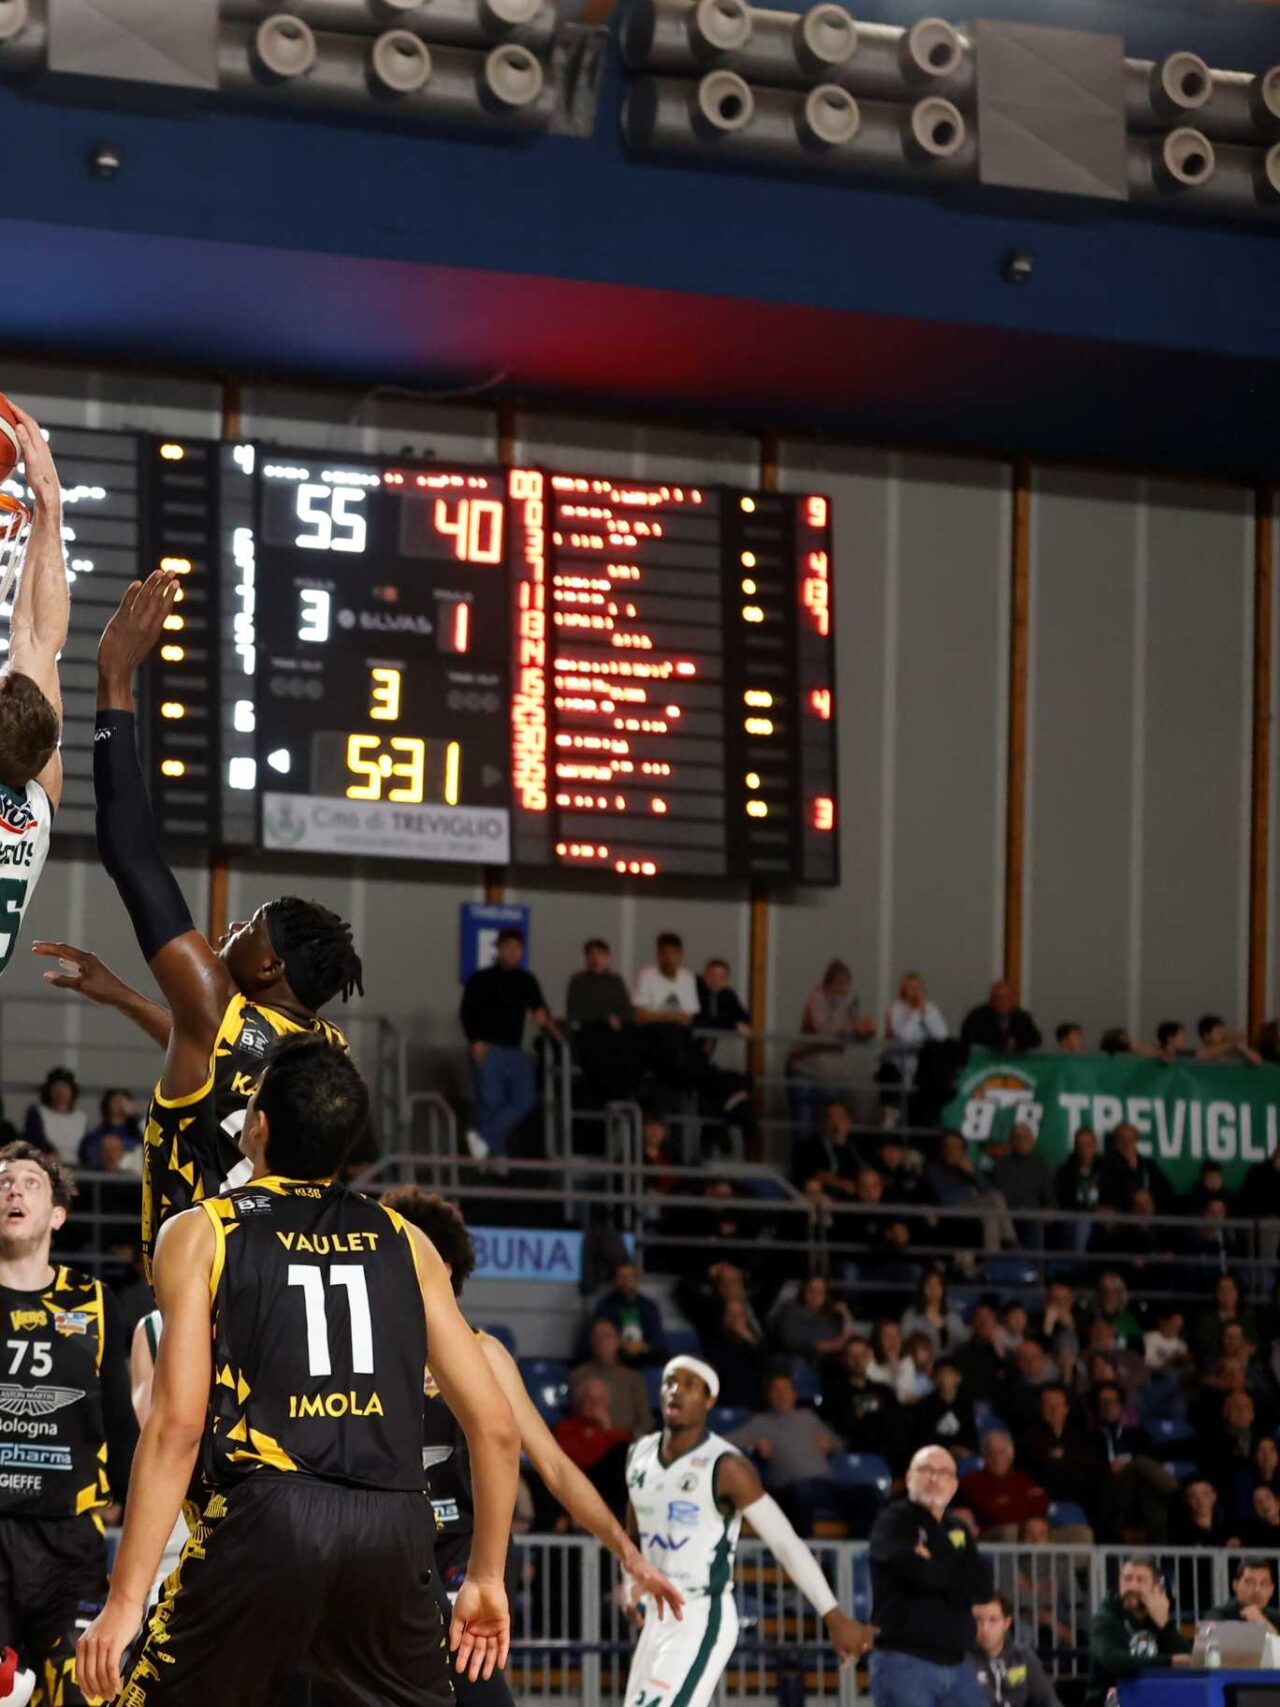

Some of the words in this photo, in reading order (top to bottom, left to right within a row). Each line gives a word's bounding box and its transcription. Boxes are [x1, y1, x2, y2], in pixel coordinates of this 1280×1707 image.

[233, 445, 255, 475] 4
[295, 484, 366, 552] 55
[525, 500, 543, 528] 0
[808, 496, 826, 527] 9
[435, 498, 503, 563] 40
[525, 528, 544, 555] 3
[526, 554, 544, 583] 7
[520, 582, 544, 610] 11
[298, 589, 330, 642] 3
[455, 602, 468, 653] 1
[370, 668, 400, 720] 3
[812, 689, 830, 719] 4
[391, 809, 504, 840] TREVIGLIO
[814, 798, 833, 829] 3
[277, 1231, 380, 1255] VAULET
[287, 1264, 375, 1377] 11
[6, 1339, 53, 1377] 75
[289, 1391, 385, 1418] IMOLA
